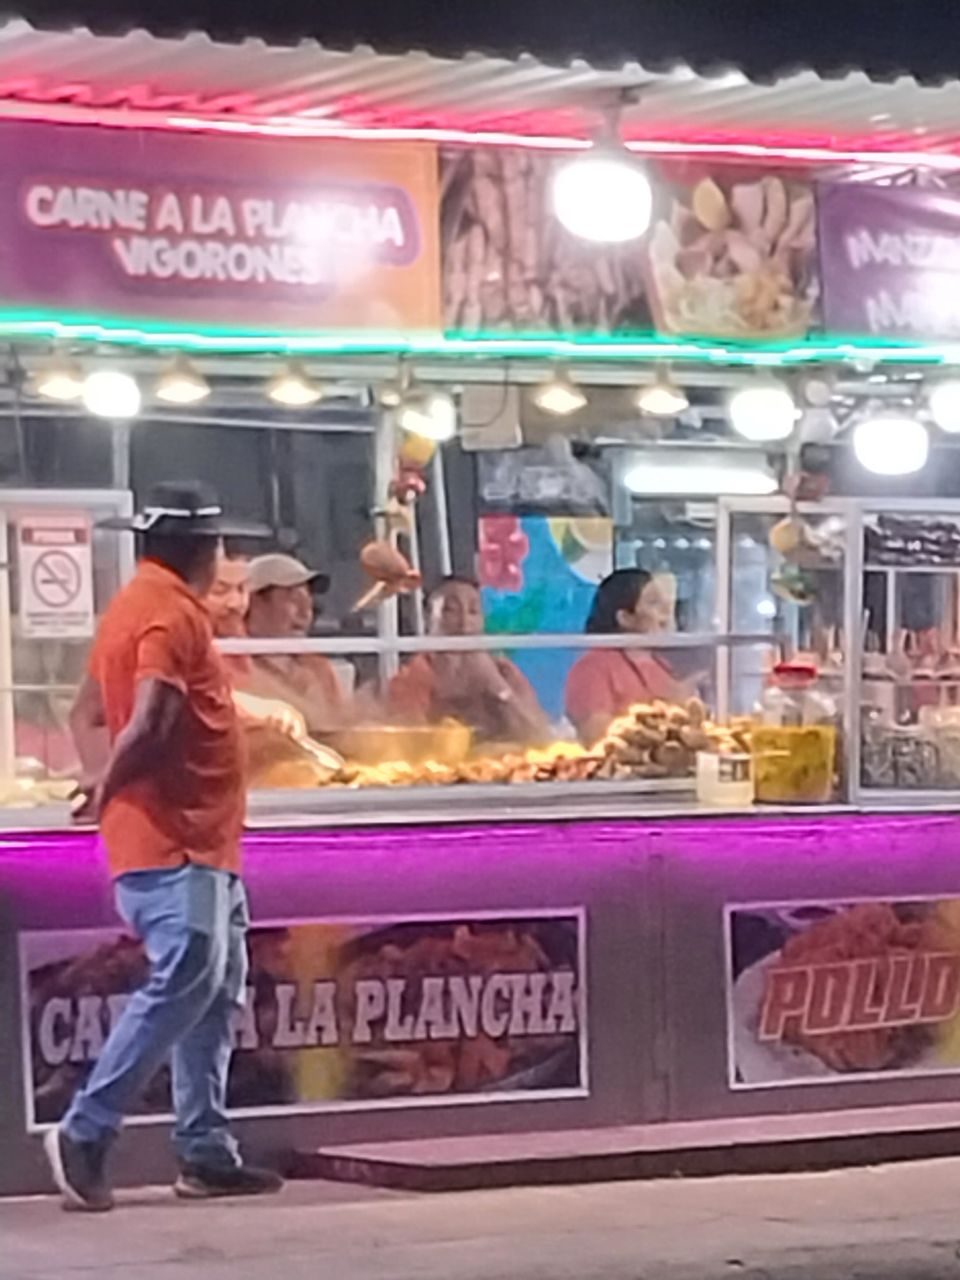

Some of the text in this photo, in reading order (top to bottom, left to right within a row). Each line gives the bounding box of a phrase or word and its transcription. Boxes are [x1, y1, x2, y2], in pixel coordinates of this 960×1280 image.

[26, 186, 405, 248] CARNE A LA PLACHA
[113, 238, 322, 284] VIGORONES
[272, 981, 340, 1048] LA
[354, 971, 579, 1045] PLANCHA
